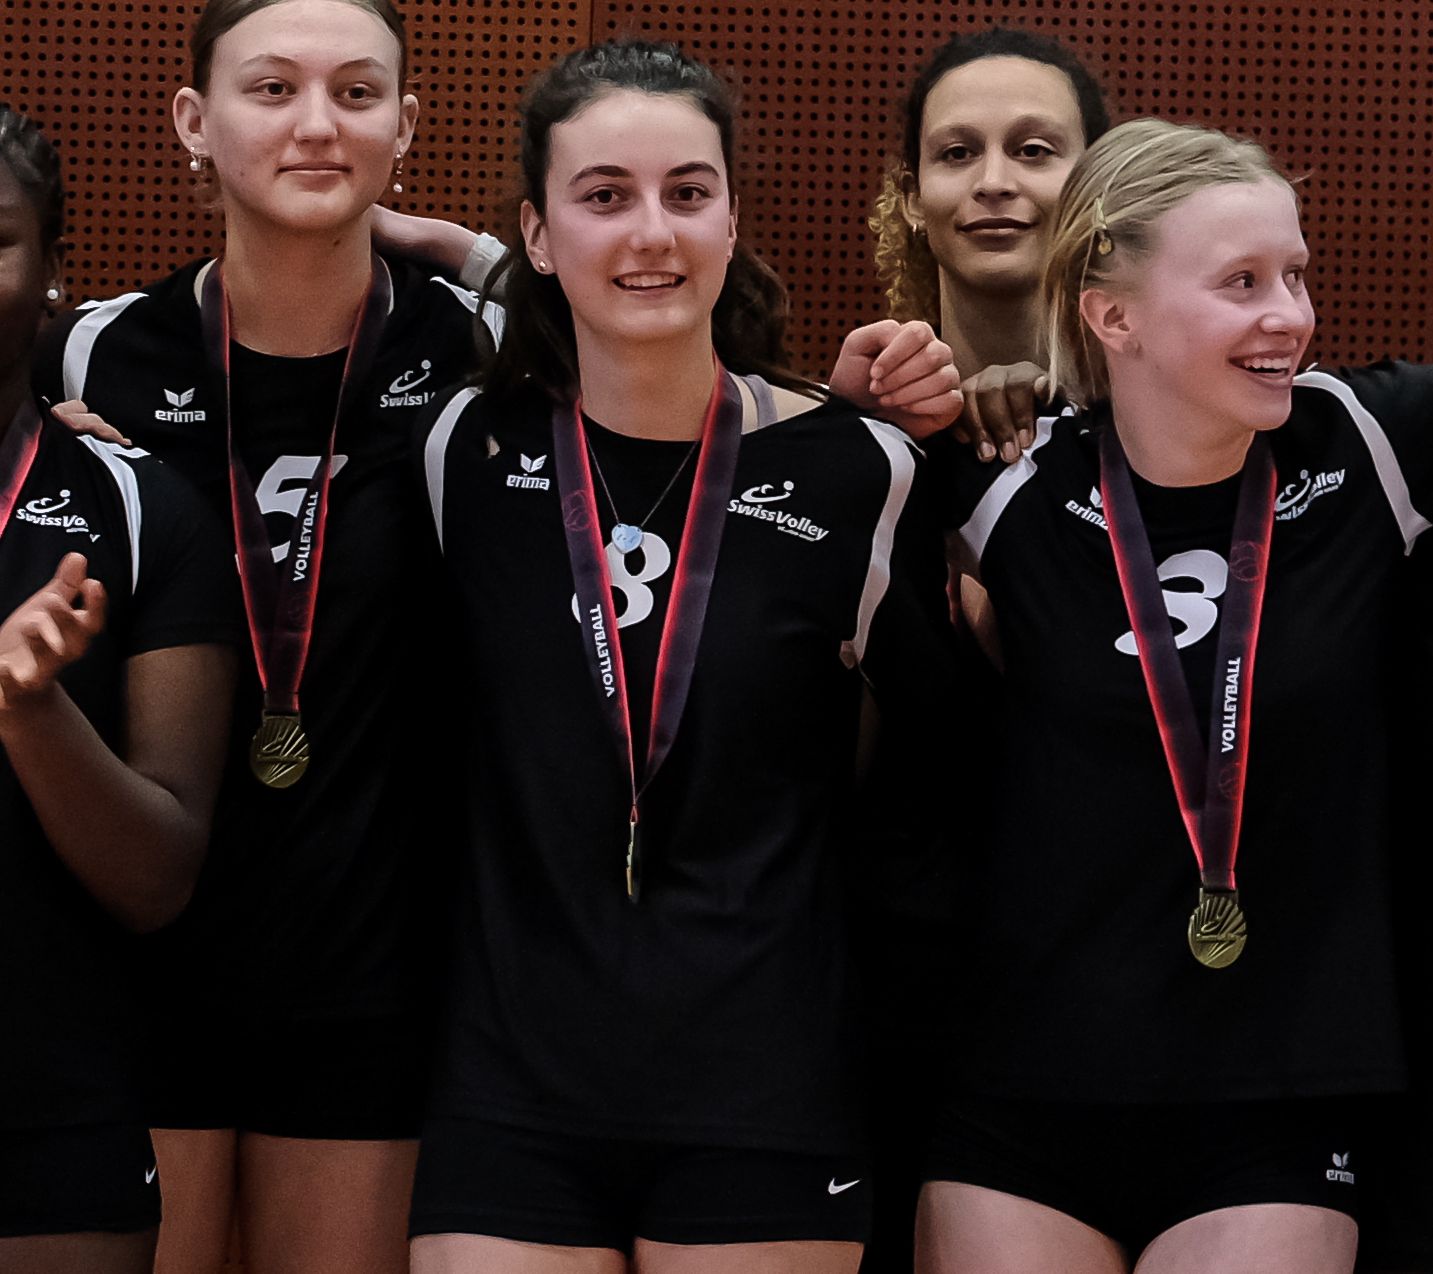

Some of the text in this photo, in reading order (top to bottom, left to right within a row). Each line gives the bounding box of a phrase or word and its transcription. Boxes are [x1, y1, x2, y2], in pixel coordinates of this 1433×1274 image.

[154, 408, 206, 423] erima
[506, 473, 550, 491] erima
[292, 490, 319, 582] VOLLEYBALL
[571, 531, 672, 629] 8
[1114, 549, 1229, 656] 3
[590, 603, 618, 697] VOLLEYBALL
[1220, 656, 1241, 753] VOLLEYBALL
